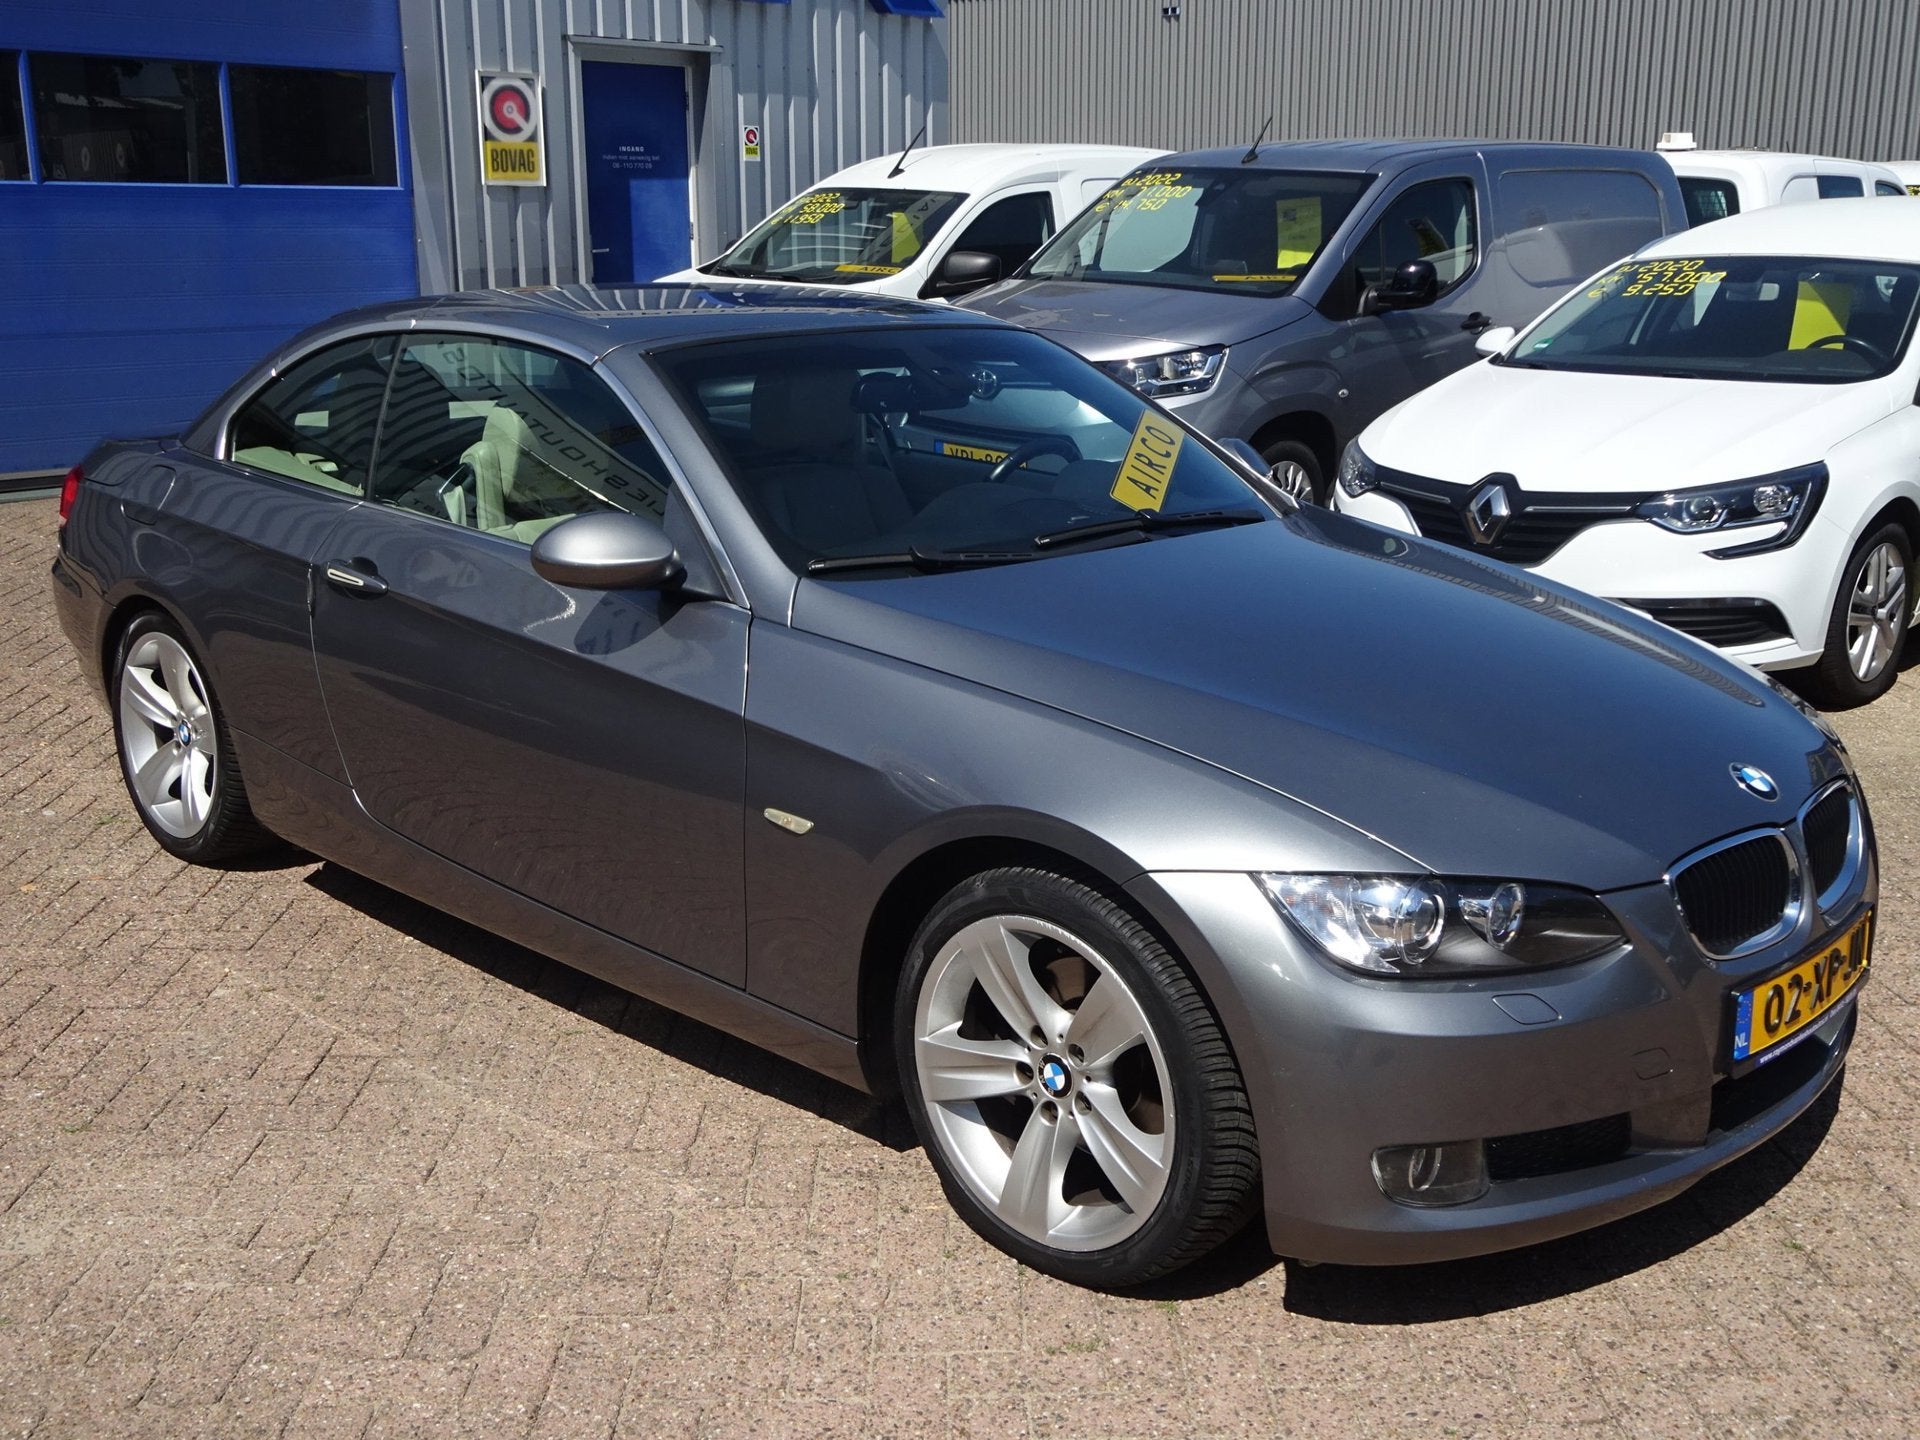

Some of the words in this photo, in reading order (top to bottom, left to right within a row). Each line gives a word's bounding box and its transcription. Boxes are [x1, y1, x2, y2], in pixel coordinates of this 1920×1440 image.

[490, 148, 535, 173] BOVAG
[1135, 173, 1181, 186] 2022
[1638, 260, 1705, 272] 2020
[1621, 283, 1696, 297] 9.250
[1126, 424, 1177, 500] AIRCO
[1734, 1031, 1748, 1048] NL
